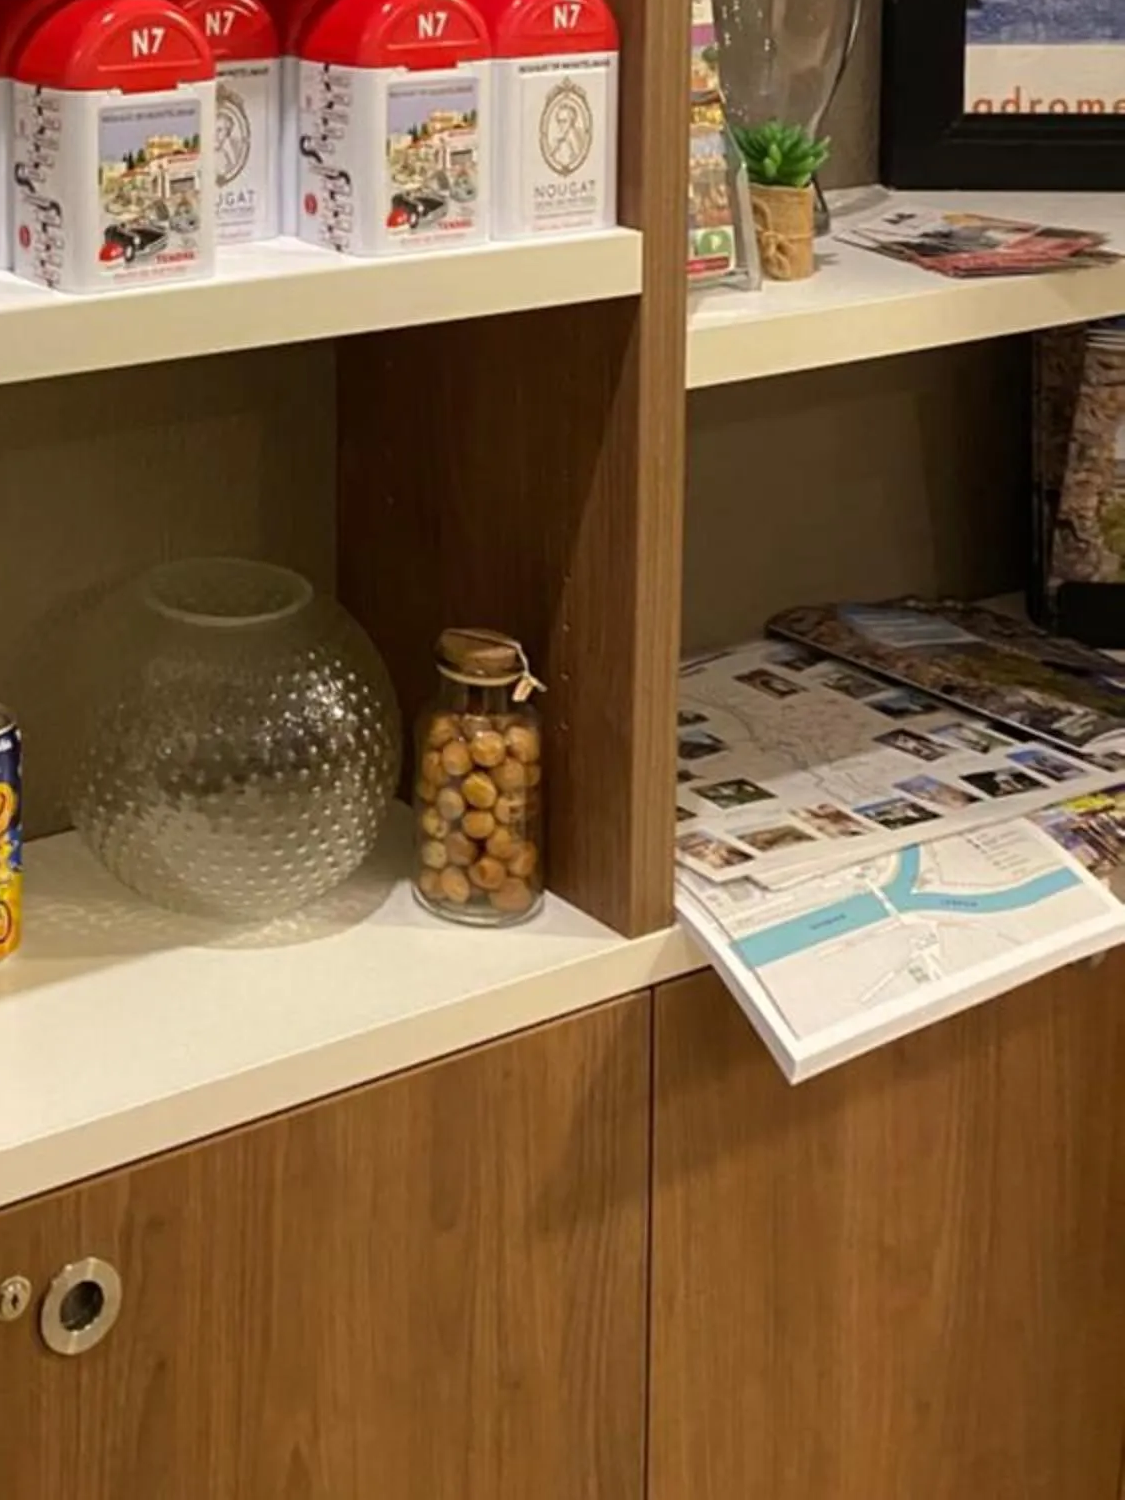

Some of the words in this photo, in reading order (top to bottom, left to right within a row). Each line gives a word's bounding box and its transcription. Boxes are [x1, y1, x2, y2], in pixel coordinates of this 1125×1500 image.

[205, 11, 235, 37] N7
[418, 12, 447, 38] N7
[553, 4, 581, 29] N7
[132, 27, 165, 58] N7
[534, 180, 596, 199] NOUGAT
